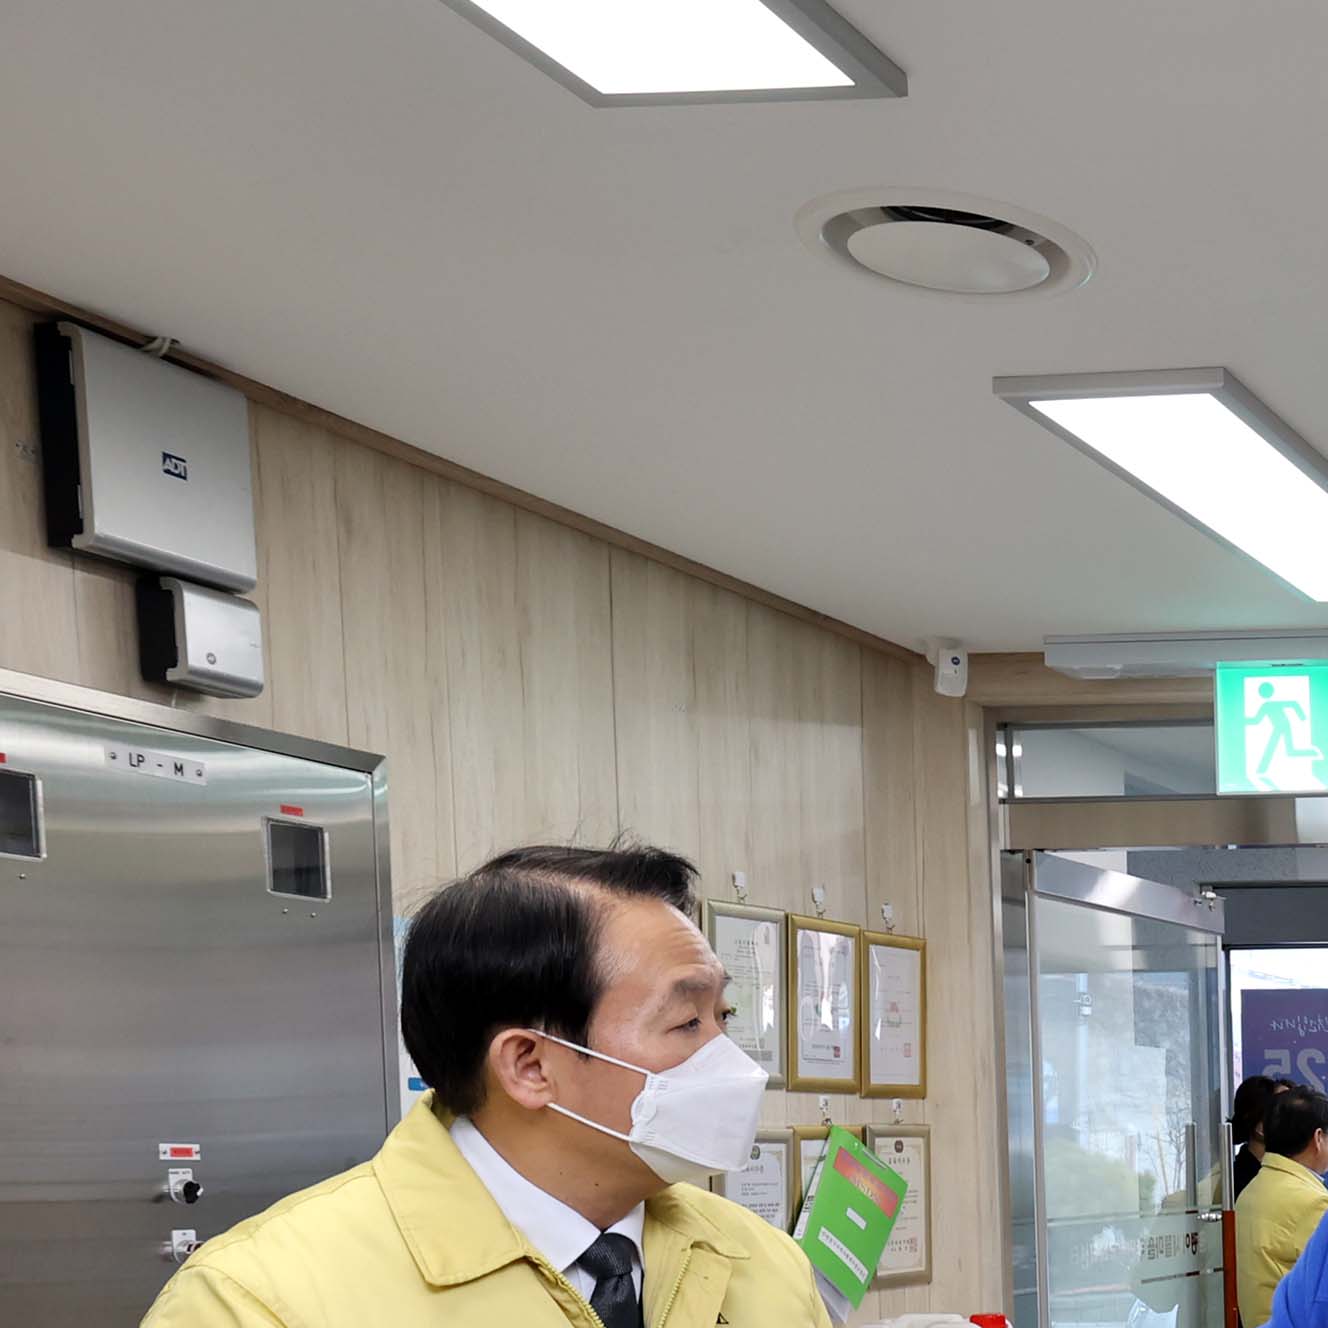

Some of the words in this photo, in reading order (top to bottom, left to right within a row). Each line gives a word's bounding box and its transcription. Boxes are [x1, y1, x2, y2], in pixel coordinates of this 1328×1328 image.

[164, 455, 187, 478] ADT
[128, 752, 145, 768] LP
[173, 763, 185, 777] M
